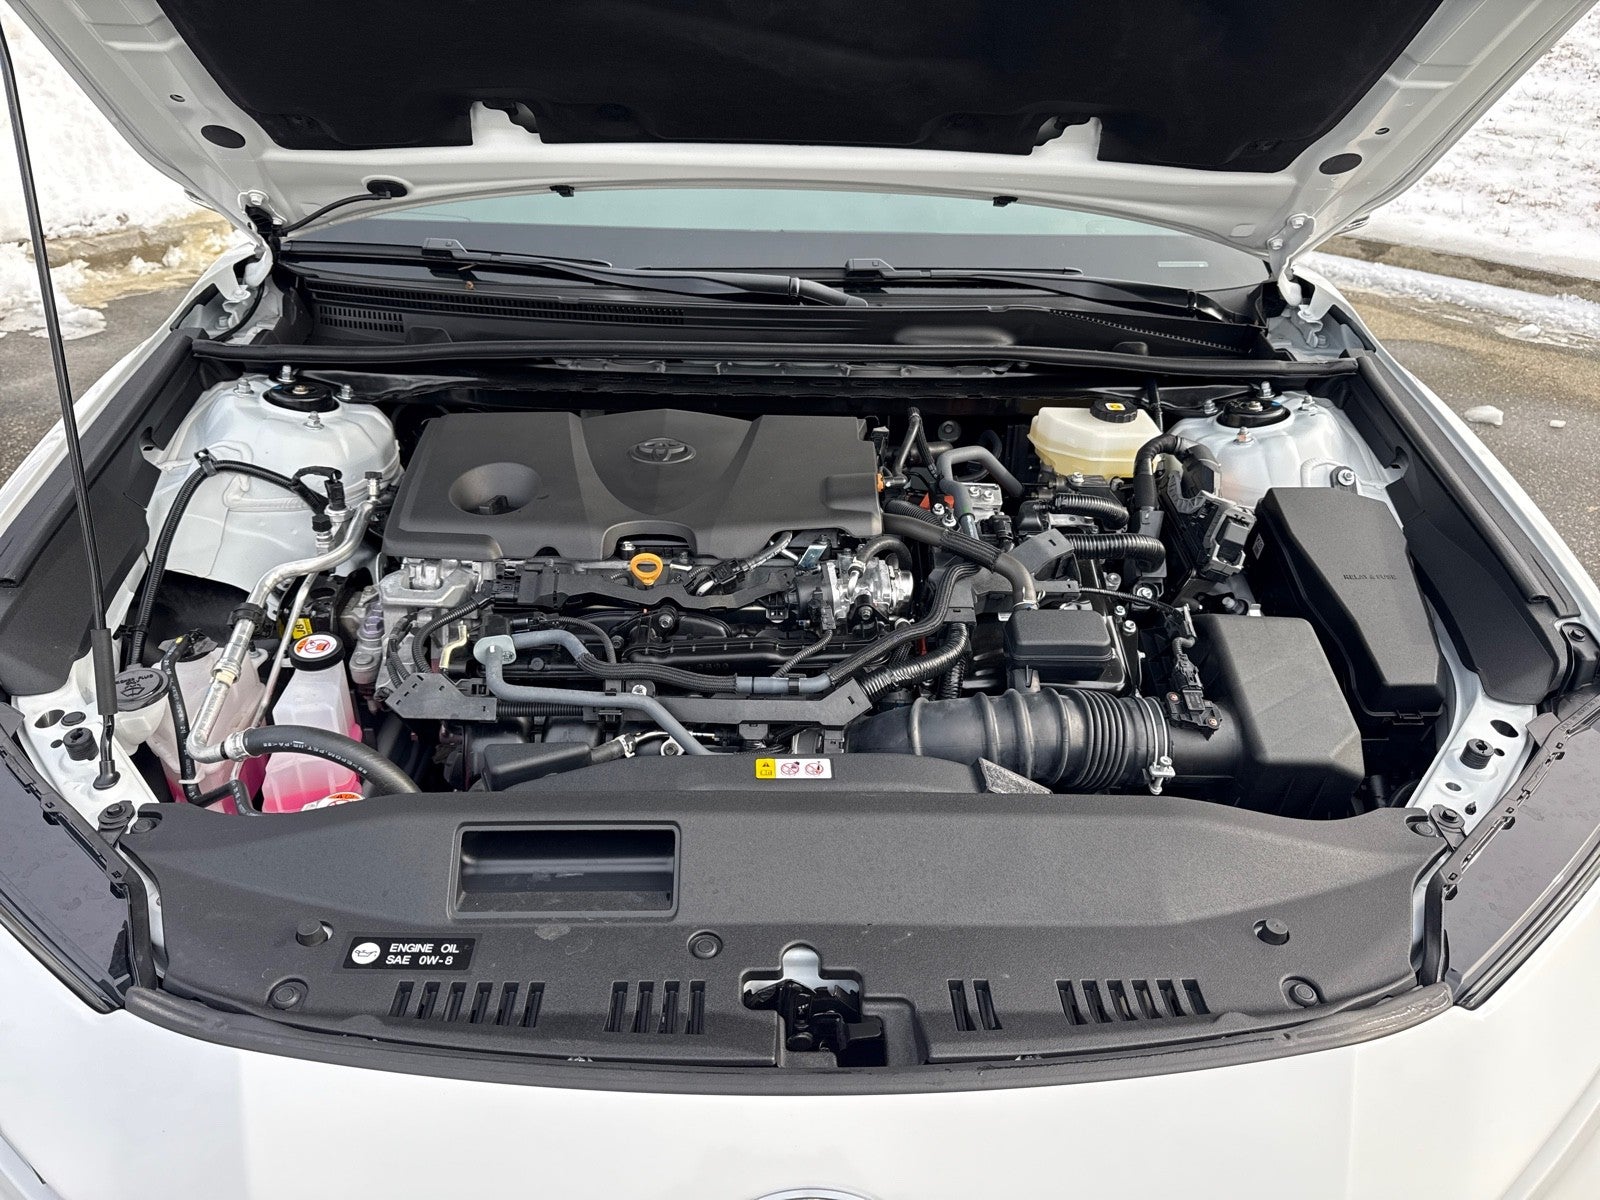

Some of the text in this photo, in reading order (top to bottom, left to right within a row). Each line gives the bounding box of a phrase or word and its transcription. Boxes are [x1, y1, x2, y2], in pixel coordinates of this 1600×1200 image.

[389, 943, 460, 953] ENGINE OIL
[386, 955, 453, 965] SAE 0W-8
